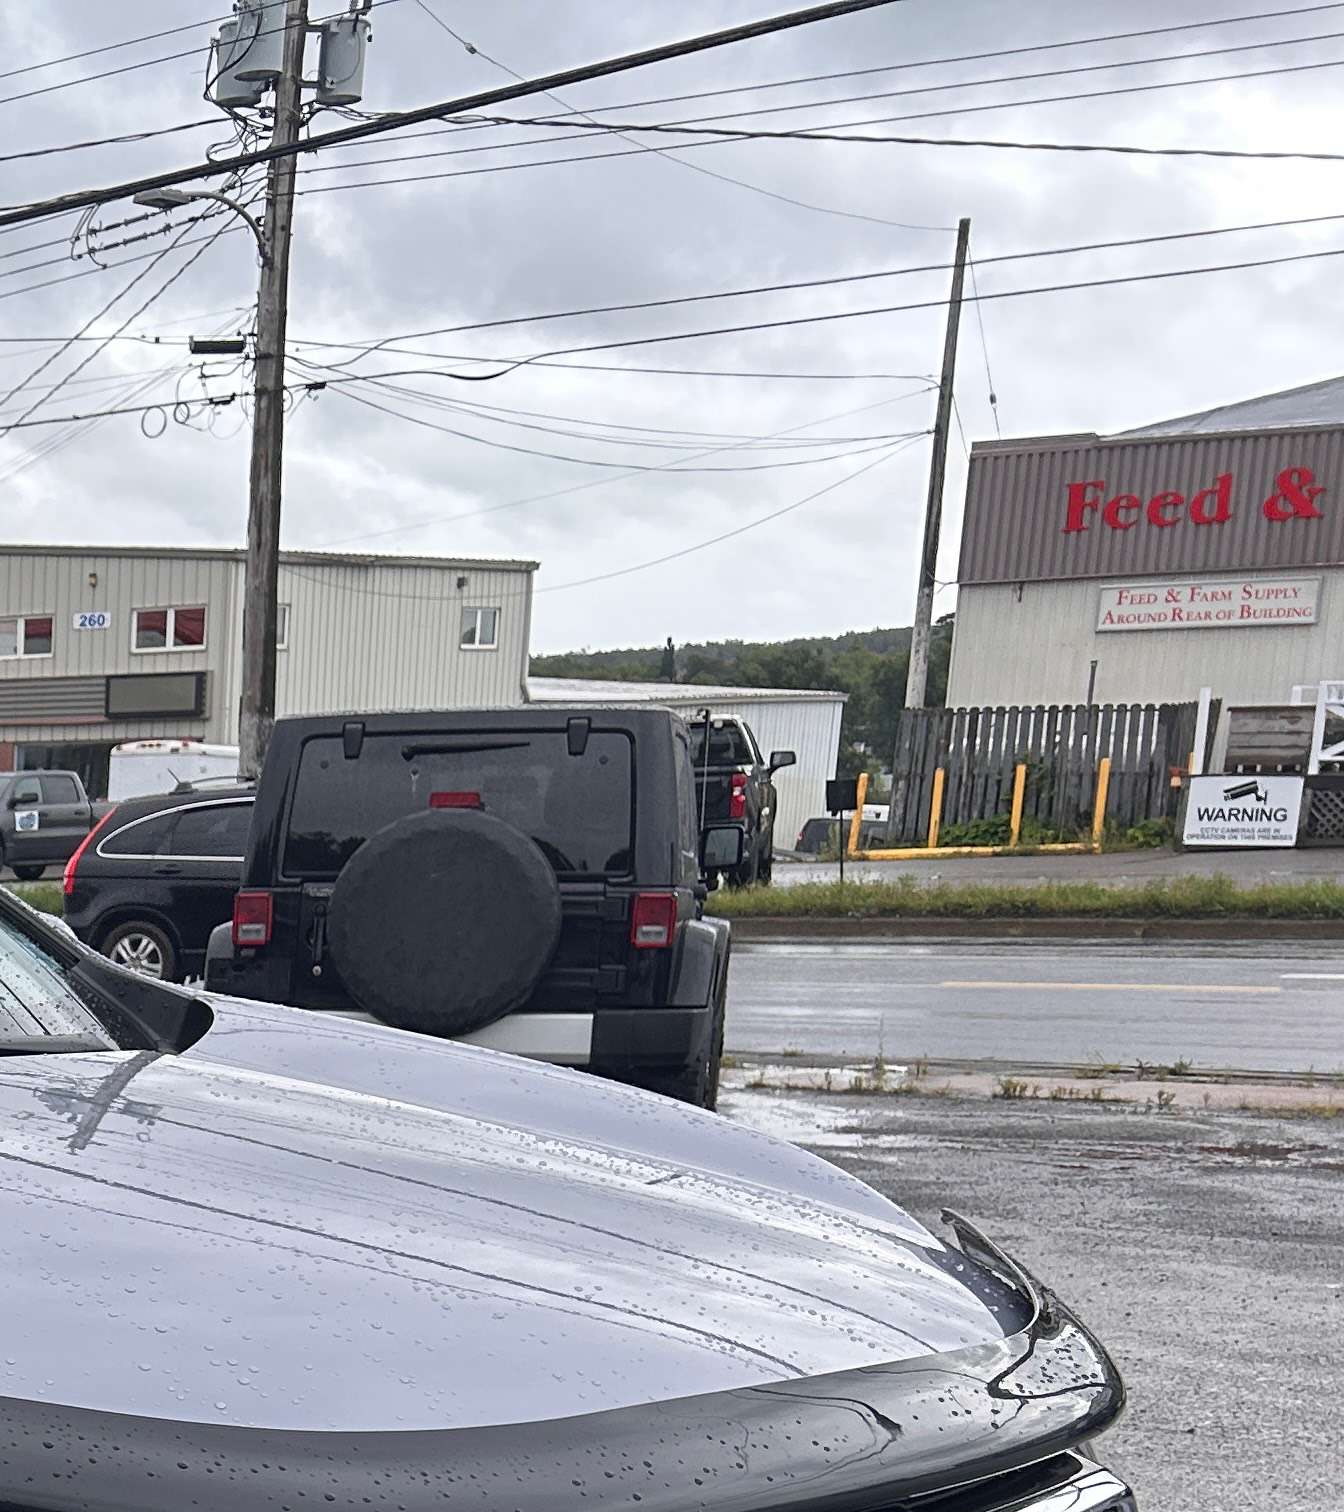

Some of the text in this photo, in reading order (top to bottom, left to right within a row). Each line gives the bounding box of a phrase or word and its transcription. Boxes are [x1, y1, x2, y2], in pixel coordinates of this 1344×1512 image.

[1061, 466, 1327, 534] Feed &
[1165, 587, 1182, 603] &
[79, 614, 105, 627] 260
[1197, 807, 1288, 822] WARNING
